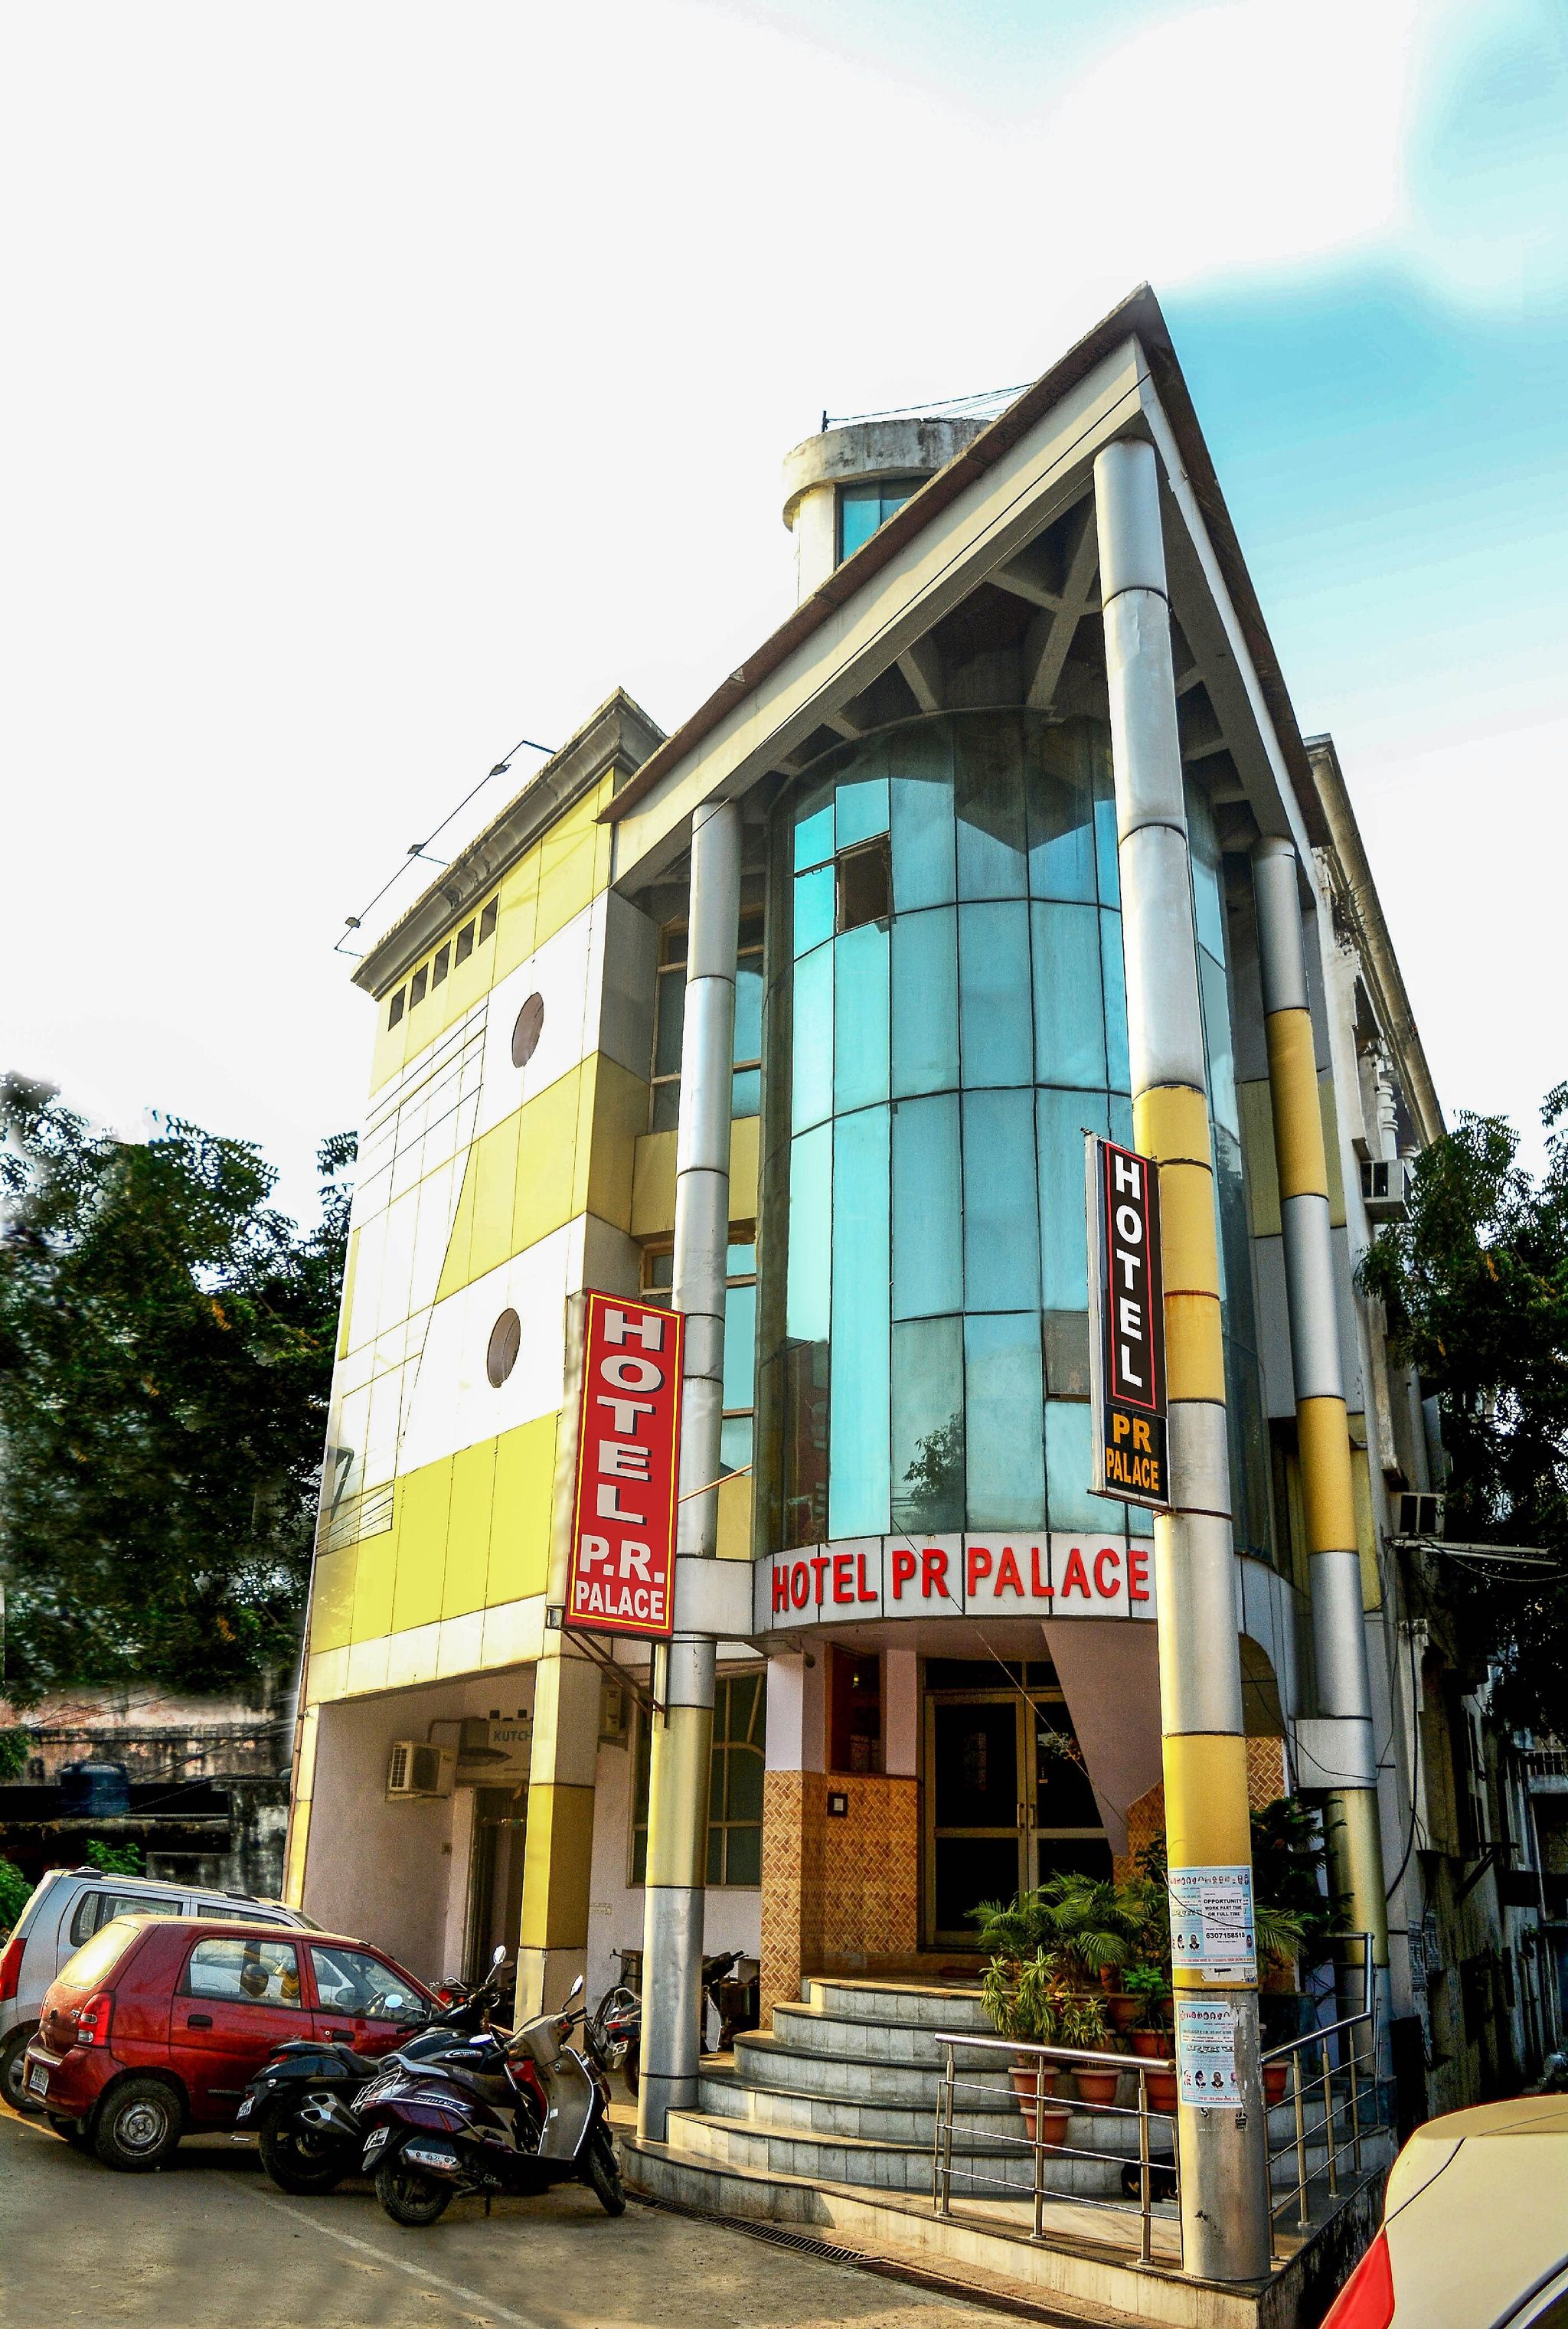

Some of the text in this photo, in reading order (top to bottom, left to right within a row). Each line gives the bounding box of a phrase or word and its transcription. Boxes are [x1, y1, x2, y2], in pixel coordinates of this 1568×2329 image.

[1116, 1155, 1143, 1387] HOTEL
[596, 1308, 664, 1523] HOTEL
[1113, 1415, 1152, 1453] PR
[1106, 1452, 1158, 1491] PALACE
[580, 1534, 665, 1583] P.R.
[773, 1547, 1148, 1612] HOTEL PR PALACE
[576, 1580, 664, 1621] PALACE
